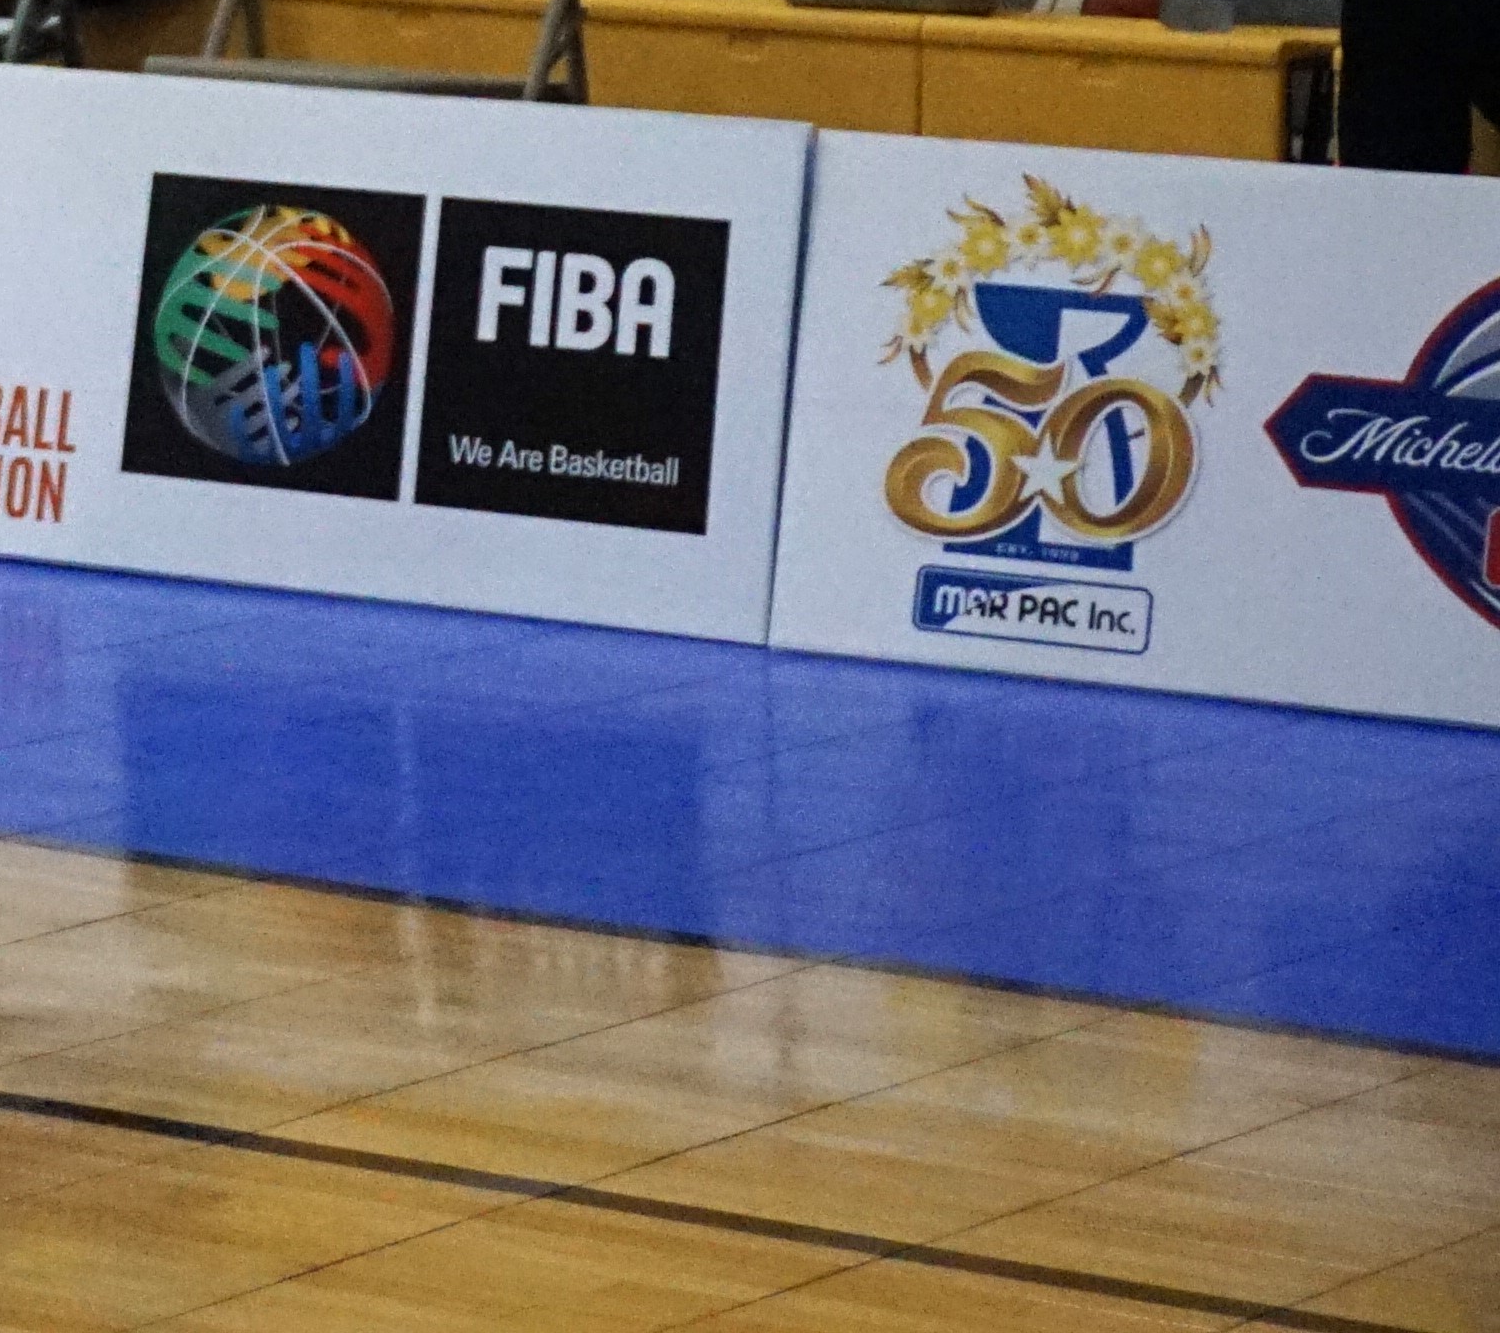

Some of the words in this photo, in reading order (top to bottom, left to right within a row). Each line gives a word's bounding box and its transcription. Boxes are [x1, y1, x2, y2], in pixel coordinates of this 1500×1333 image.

[476, 244, 677, 359] FIBA
[449, 434, 493, 468] We
[497, 439, 545, 473] Are
[550, 443, 681, 487] Basketball
[883, 350, 1198, 543] 50
[1018, 594, 1080, 629] PAC
[1088, 601, 1136, 636] Inc.
